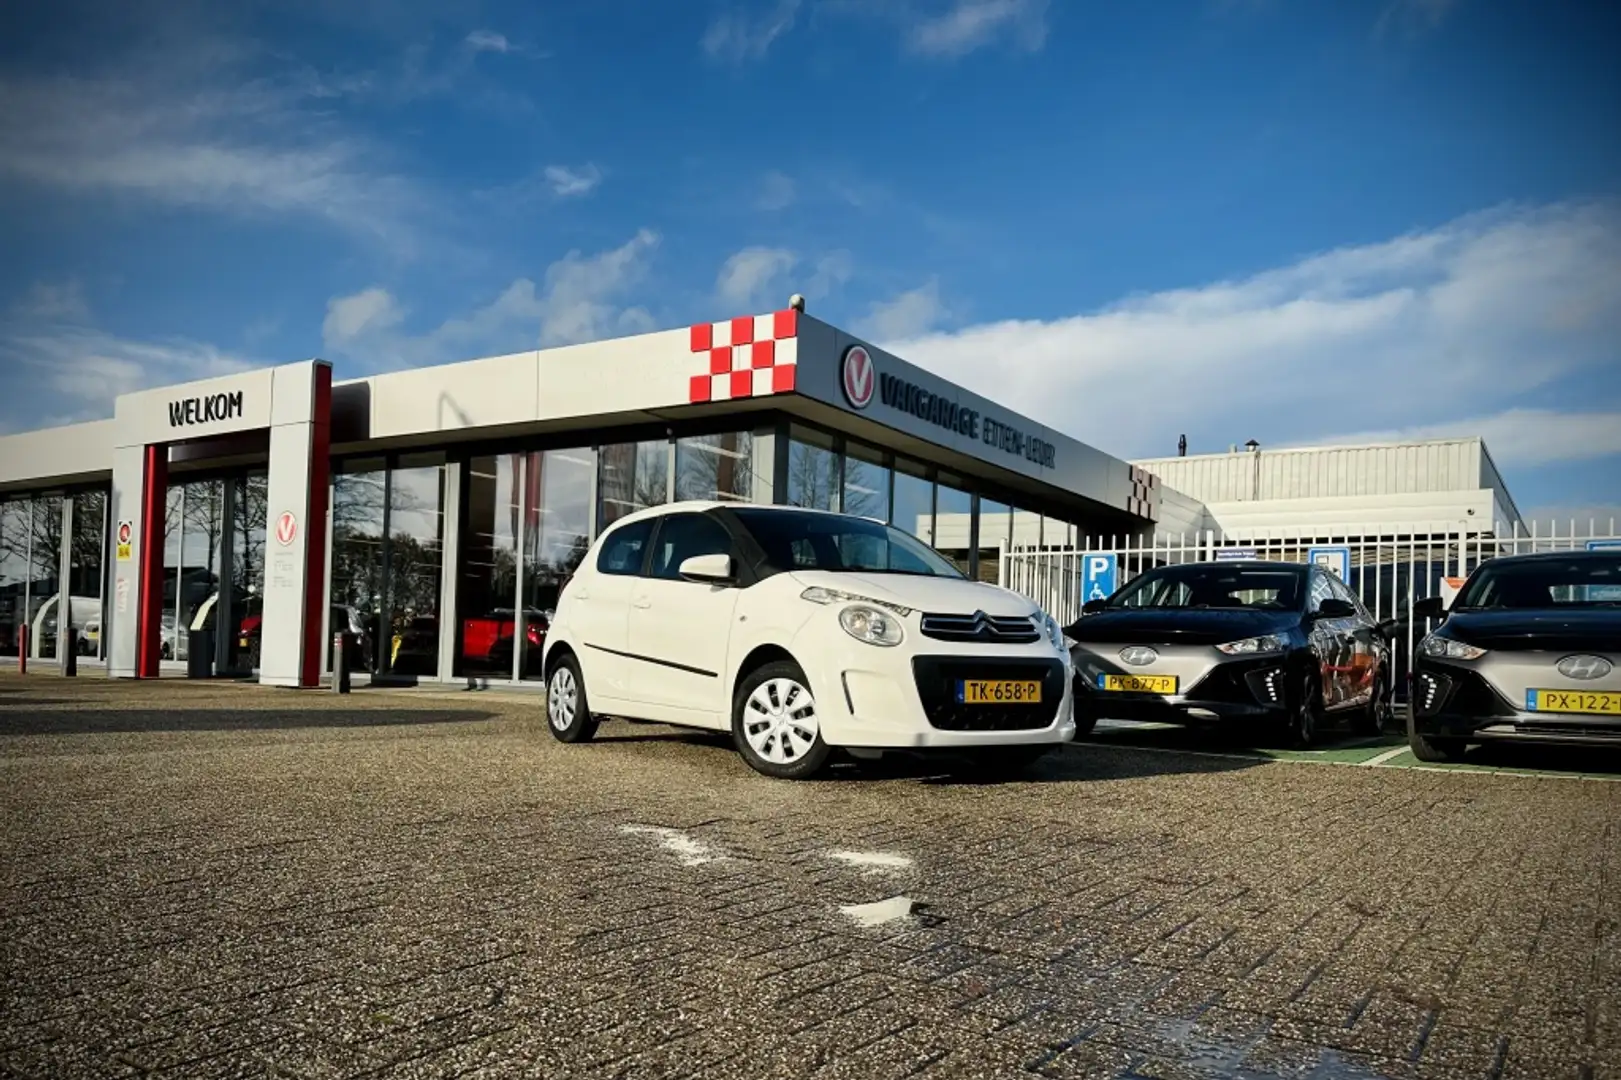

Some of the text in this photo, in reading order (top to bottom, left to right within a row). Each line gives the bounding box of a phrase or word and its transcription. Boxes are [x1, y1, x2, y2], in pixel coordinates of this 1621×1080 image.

[169, 390, 243, 427] WELKOM
[880, 372, 1057, 470] VAKGARAGE ETTEN-LEUR
[1089, 557, 1109, 581] P
[970, 682, 1037, 700] TK-658-P
[1109, 676, 1170, 691] PK-877-P
[1546, 693, 1621, 711] PX-122-
